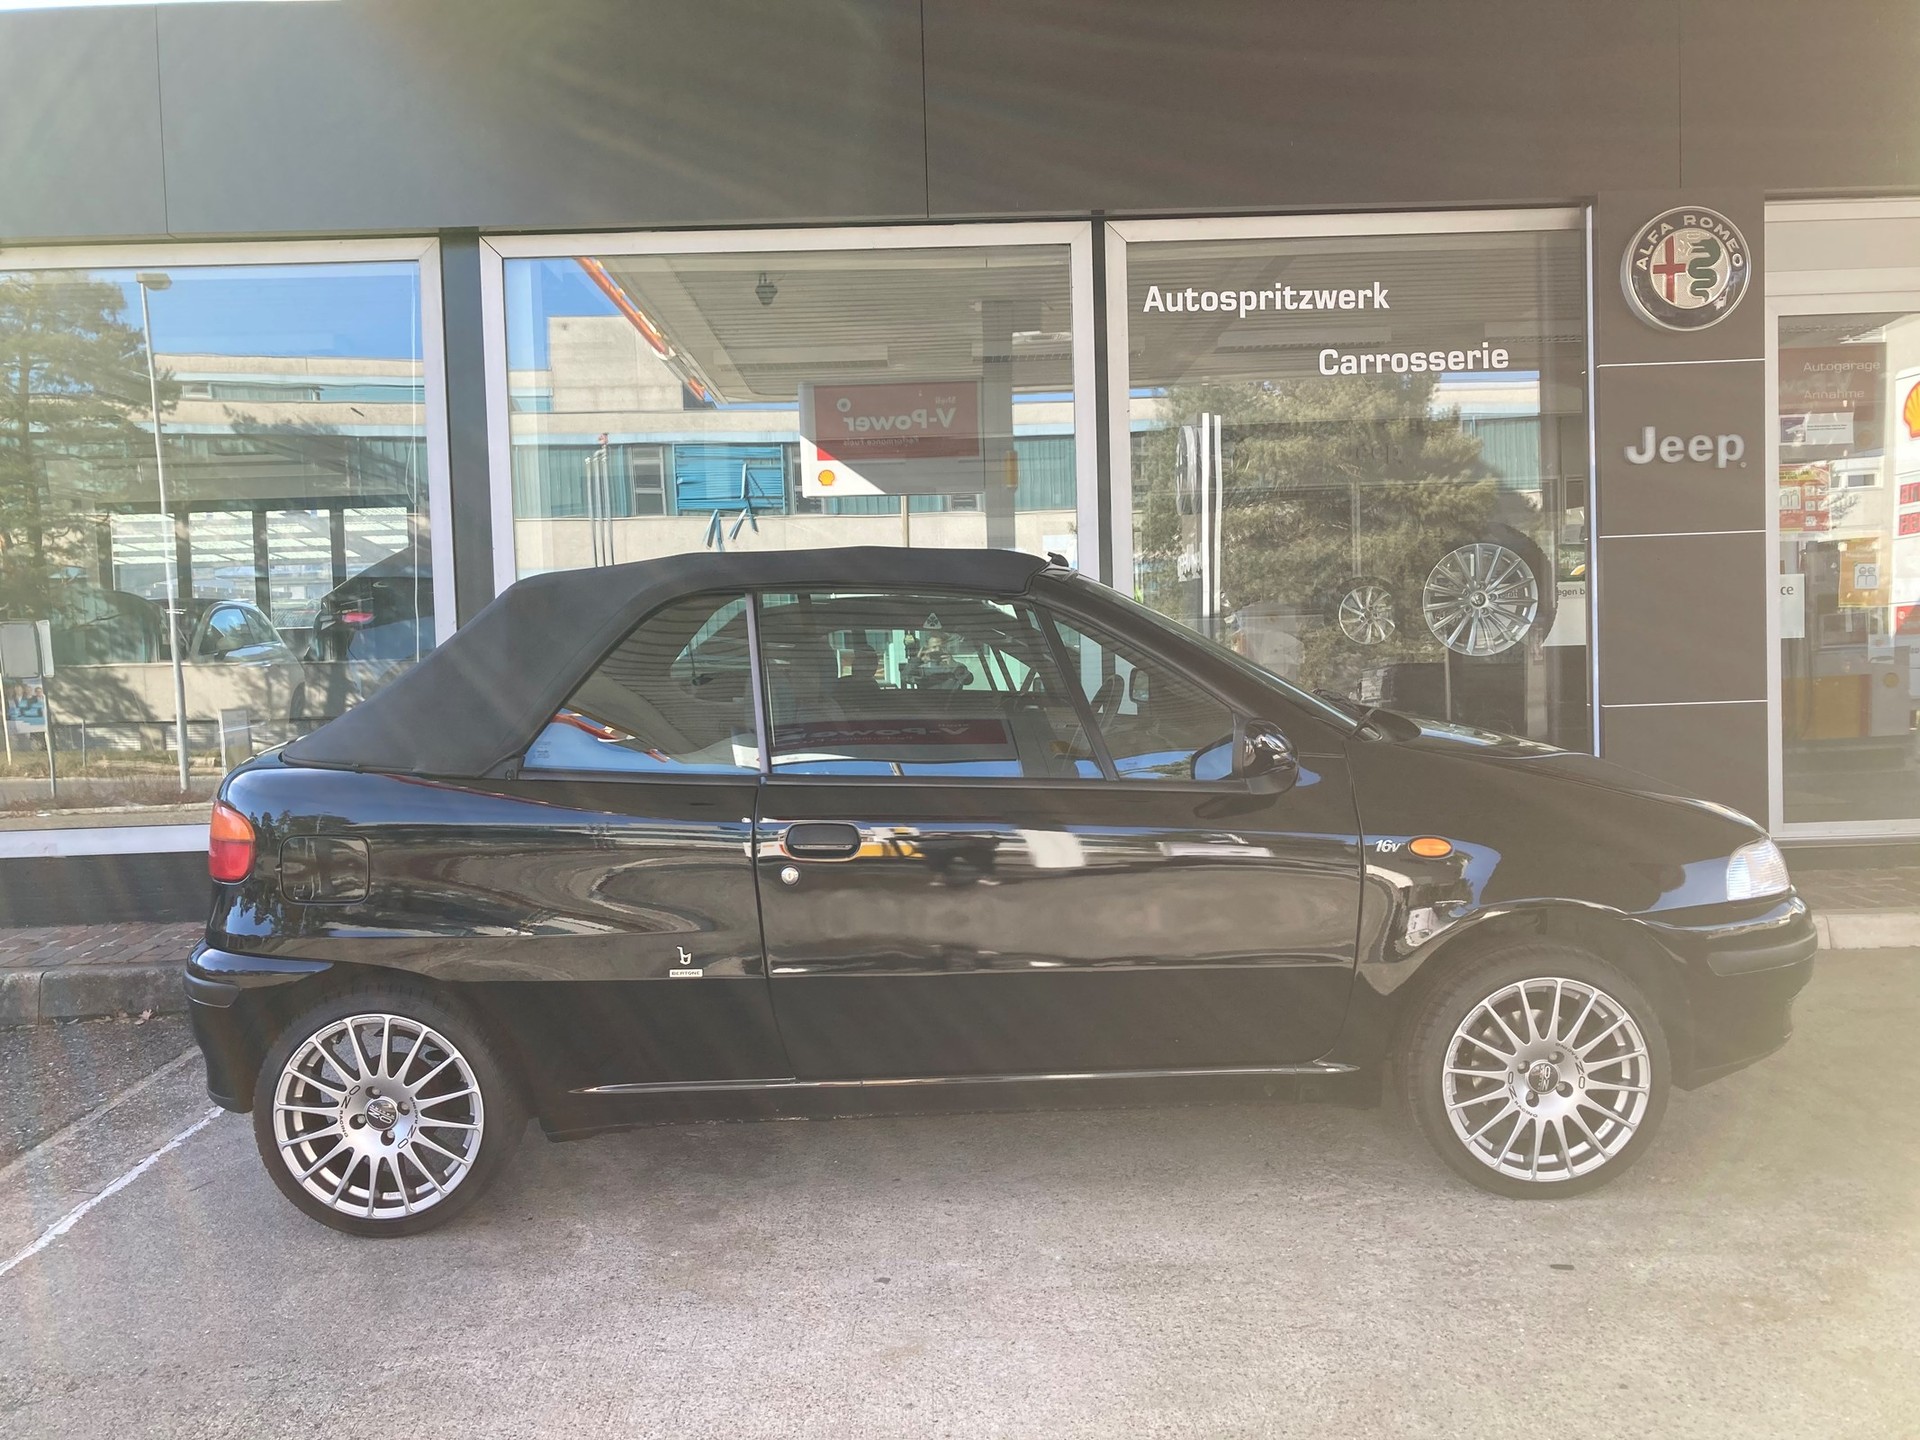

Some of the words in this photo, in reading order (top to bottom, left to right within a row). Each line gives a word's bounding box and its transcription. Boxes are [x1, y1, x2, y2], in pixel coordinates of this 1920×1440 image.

[1635, 222, 1675, 271] ALFA
[1682, 214, 1745, 268] ROMEO
[1142, 281, 1391, 319] Autospritzwerk
[1318, 342, 1510, 376] Carrosserie
[1802, 360, 1882, 375] Autogarage
[1803, 387, 1866, 401] Annahme
[1624, 425, 1746, 469] Jeep
